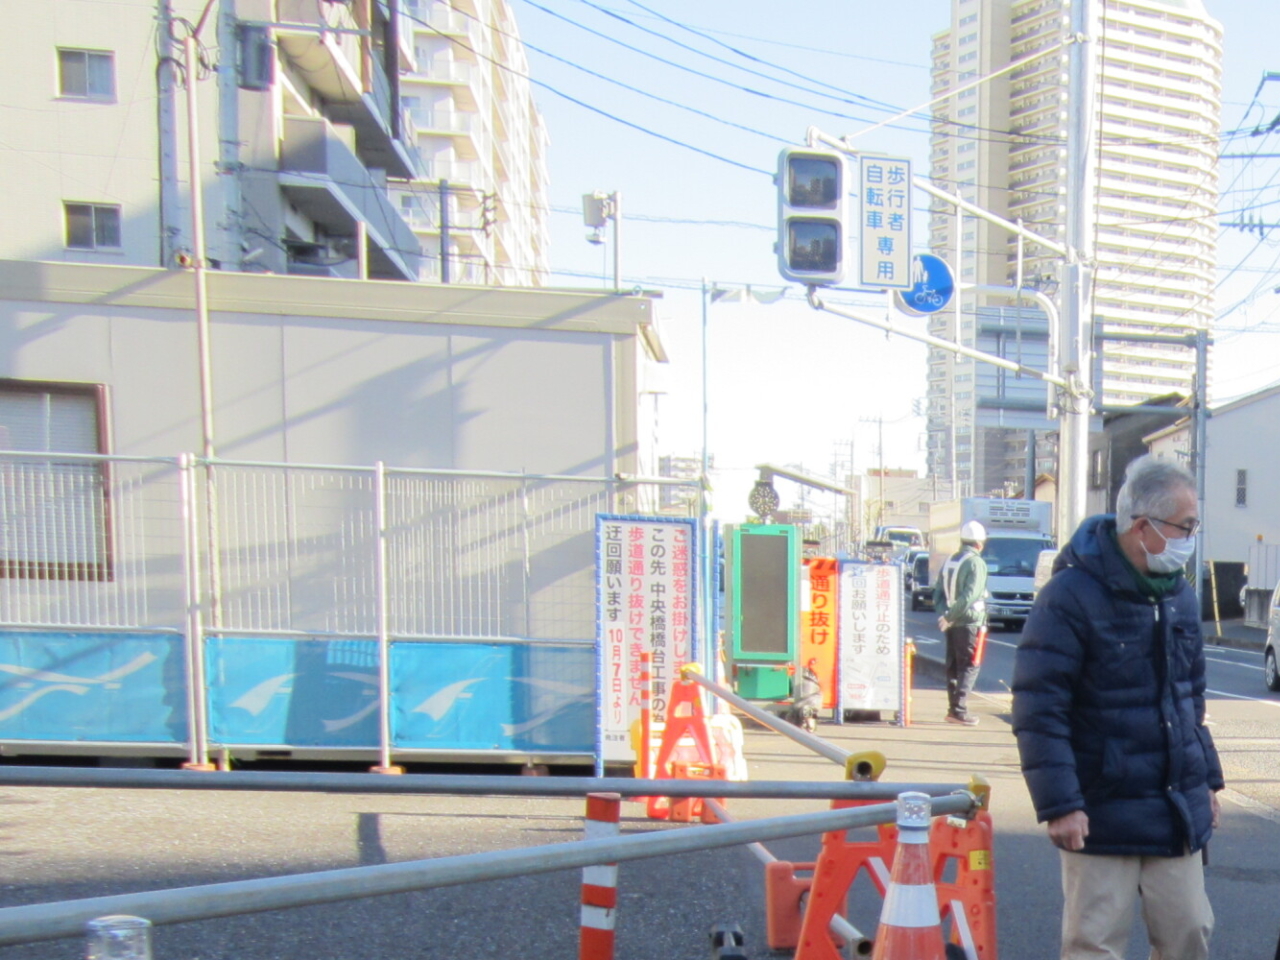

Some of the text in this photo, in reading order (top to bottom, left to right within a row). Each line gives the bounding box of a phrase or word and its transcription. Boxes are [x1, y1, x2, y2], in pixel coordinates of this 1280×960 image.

[866, 165, 884, 229] 自転車
[887, 166, 905, 231] 歩行者
[877, 236, 894, 280] 専用
[650, 528, 667, 576] この先
[672, 528, 689, 681] ご迷惑をお掛けしま
